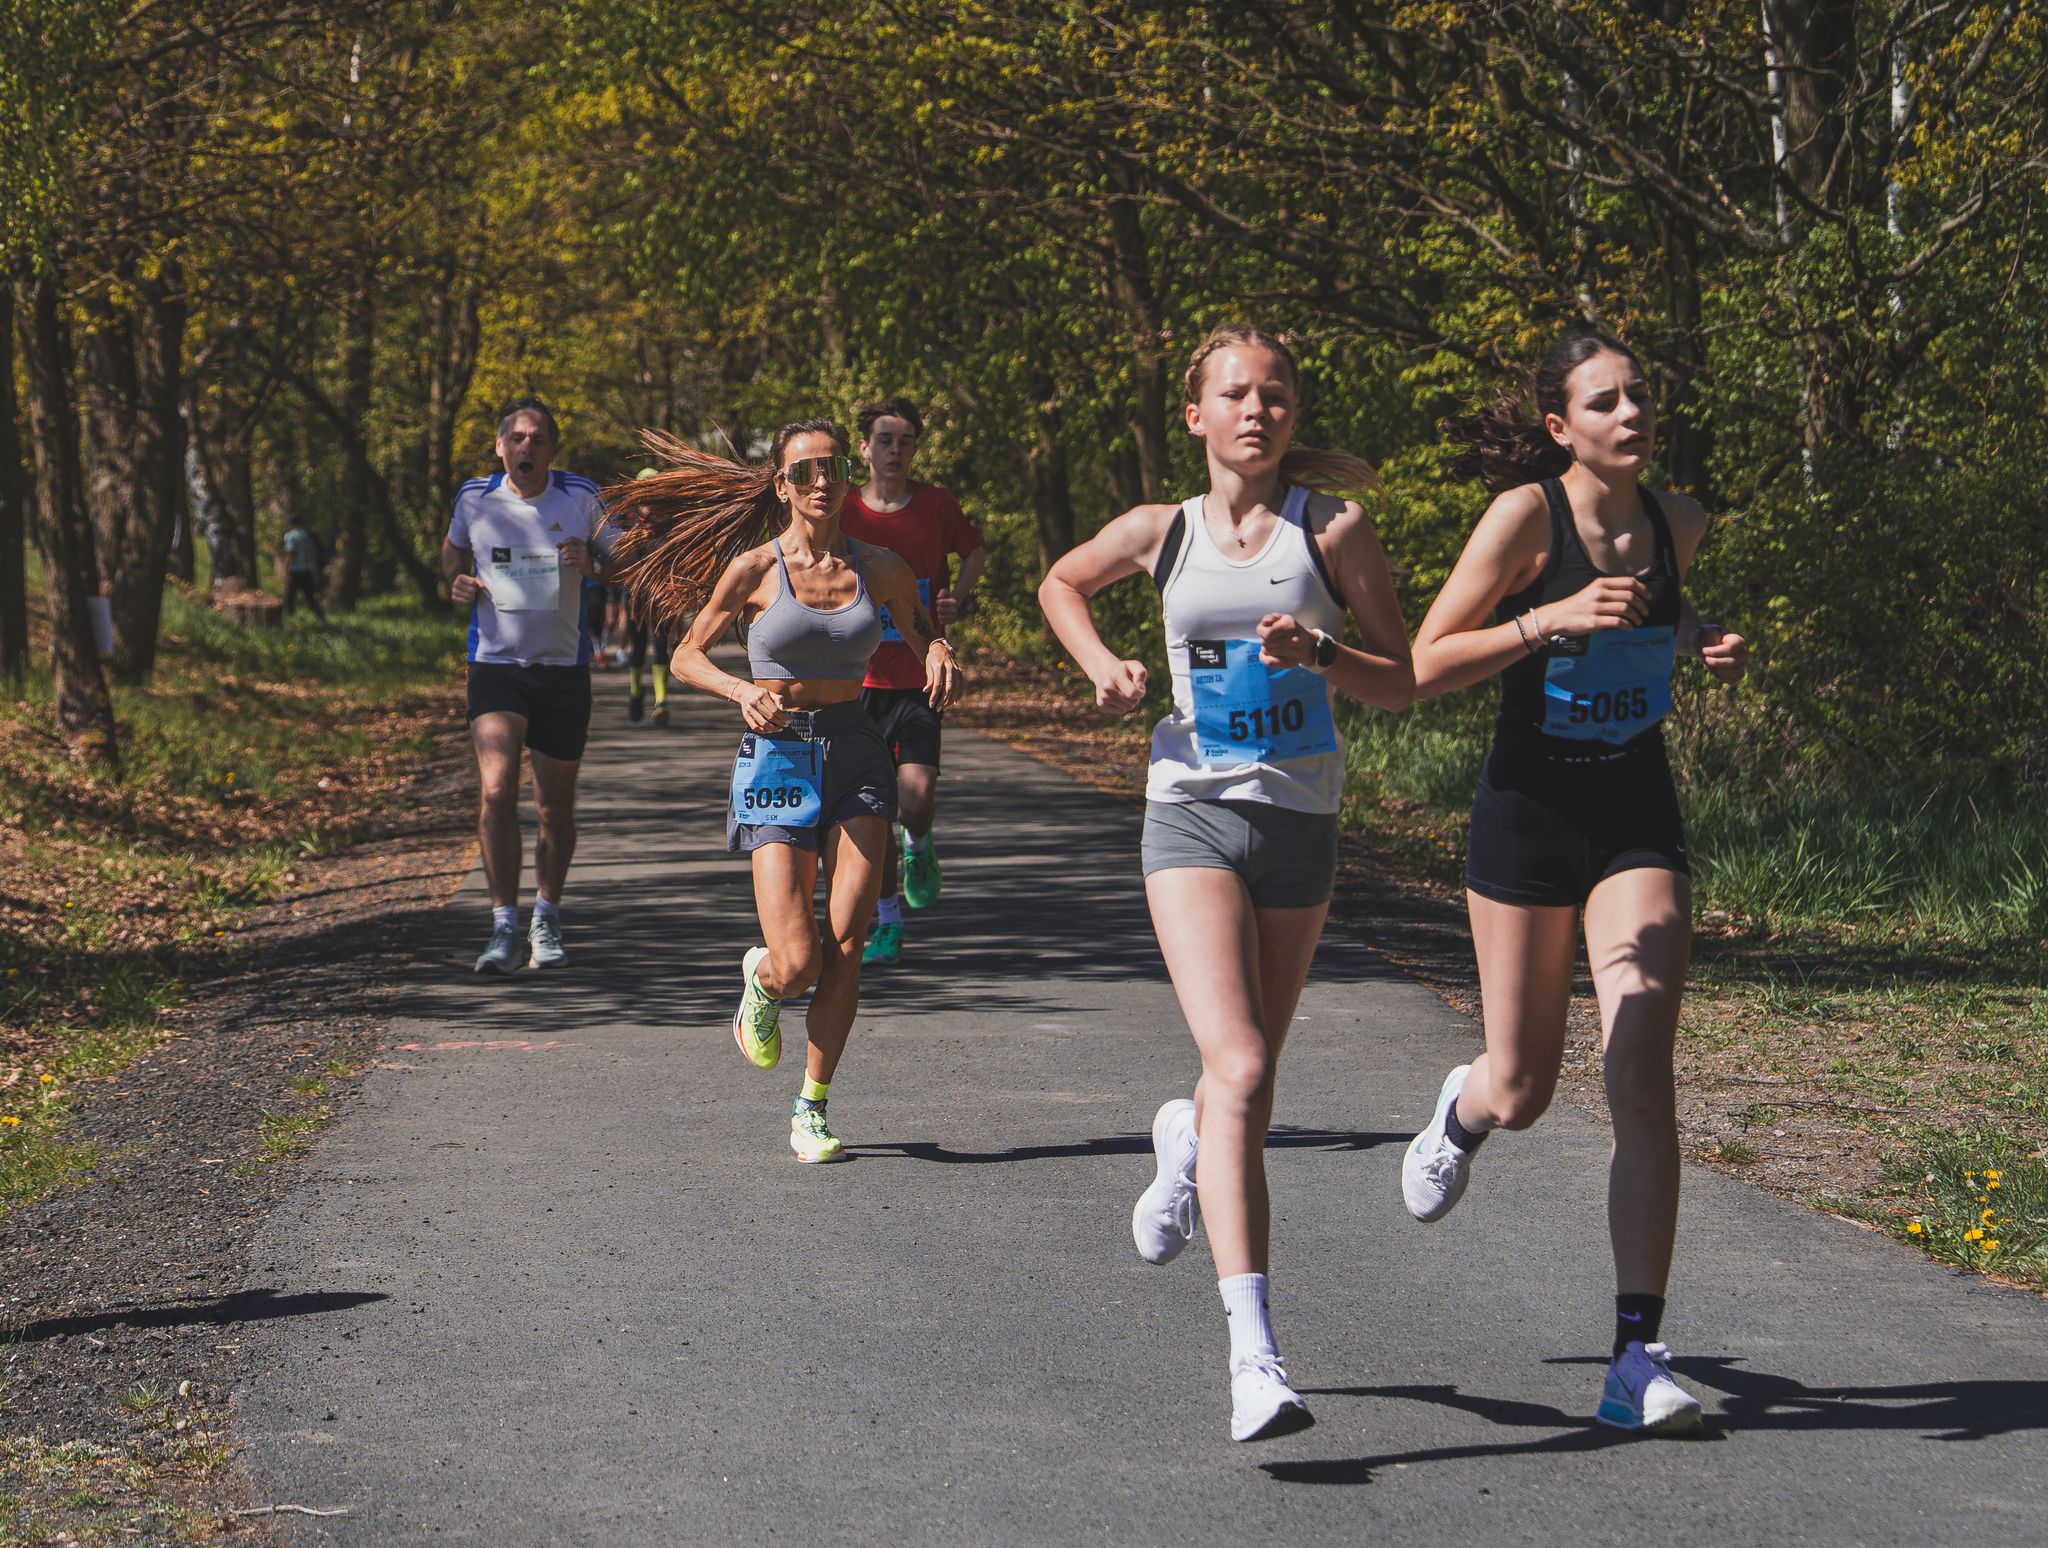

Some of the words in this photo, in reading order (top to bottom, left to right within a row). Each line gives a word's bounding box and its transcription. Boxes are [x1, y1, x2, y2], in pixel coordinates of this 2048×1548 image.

[1229, 698, 1304, 742] 5110
[1568, 687, 1648, 724] 5065
[743, 786, 803, 810] 5036
